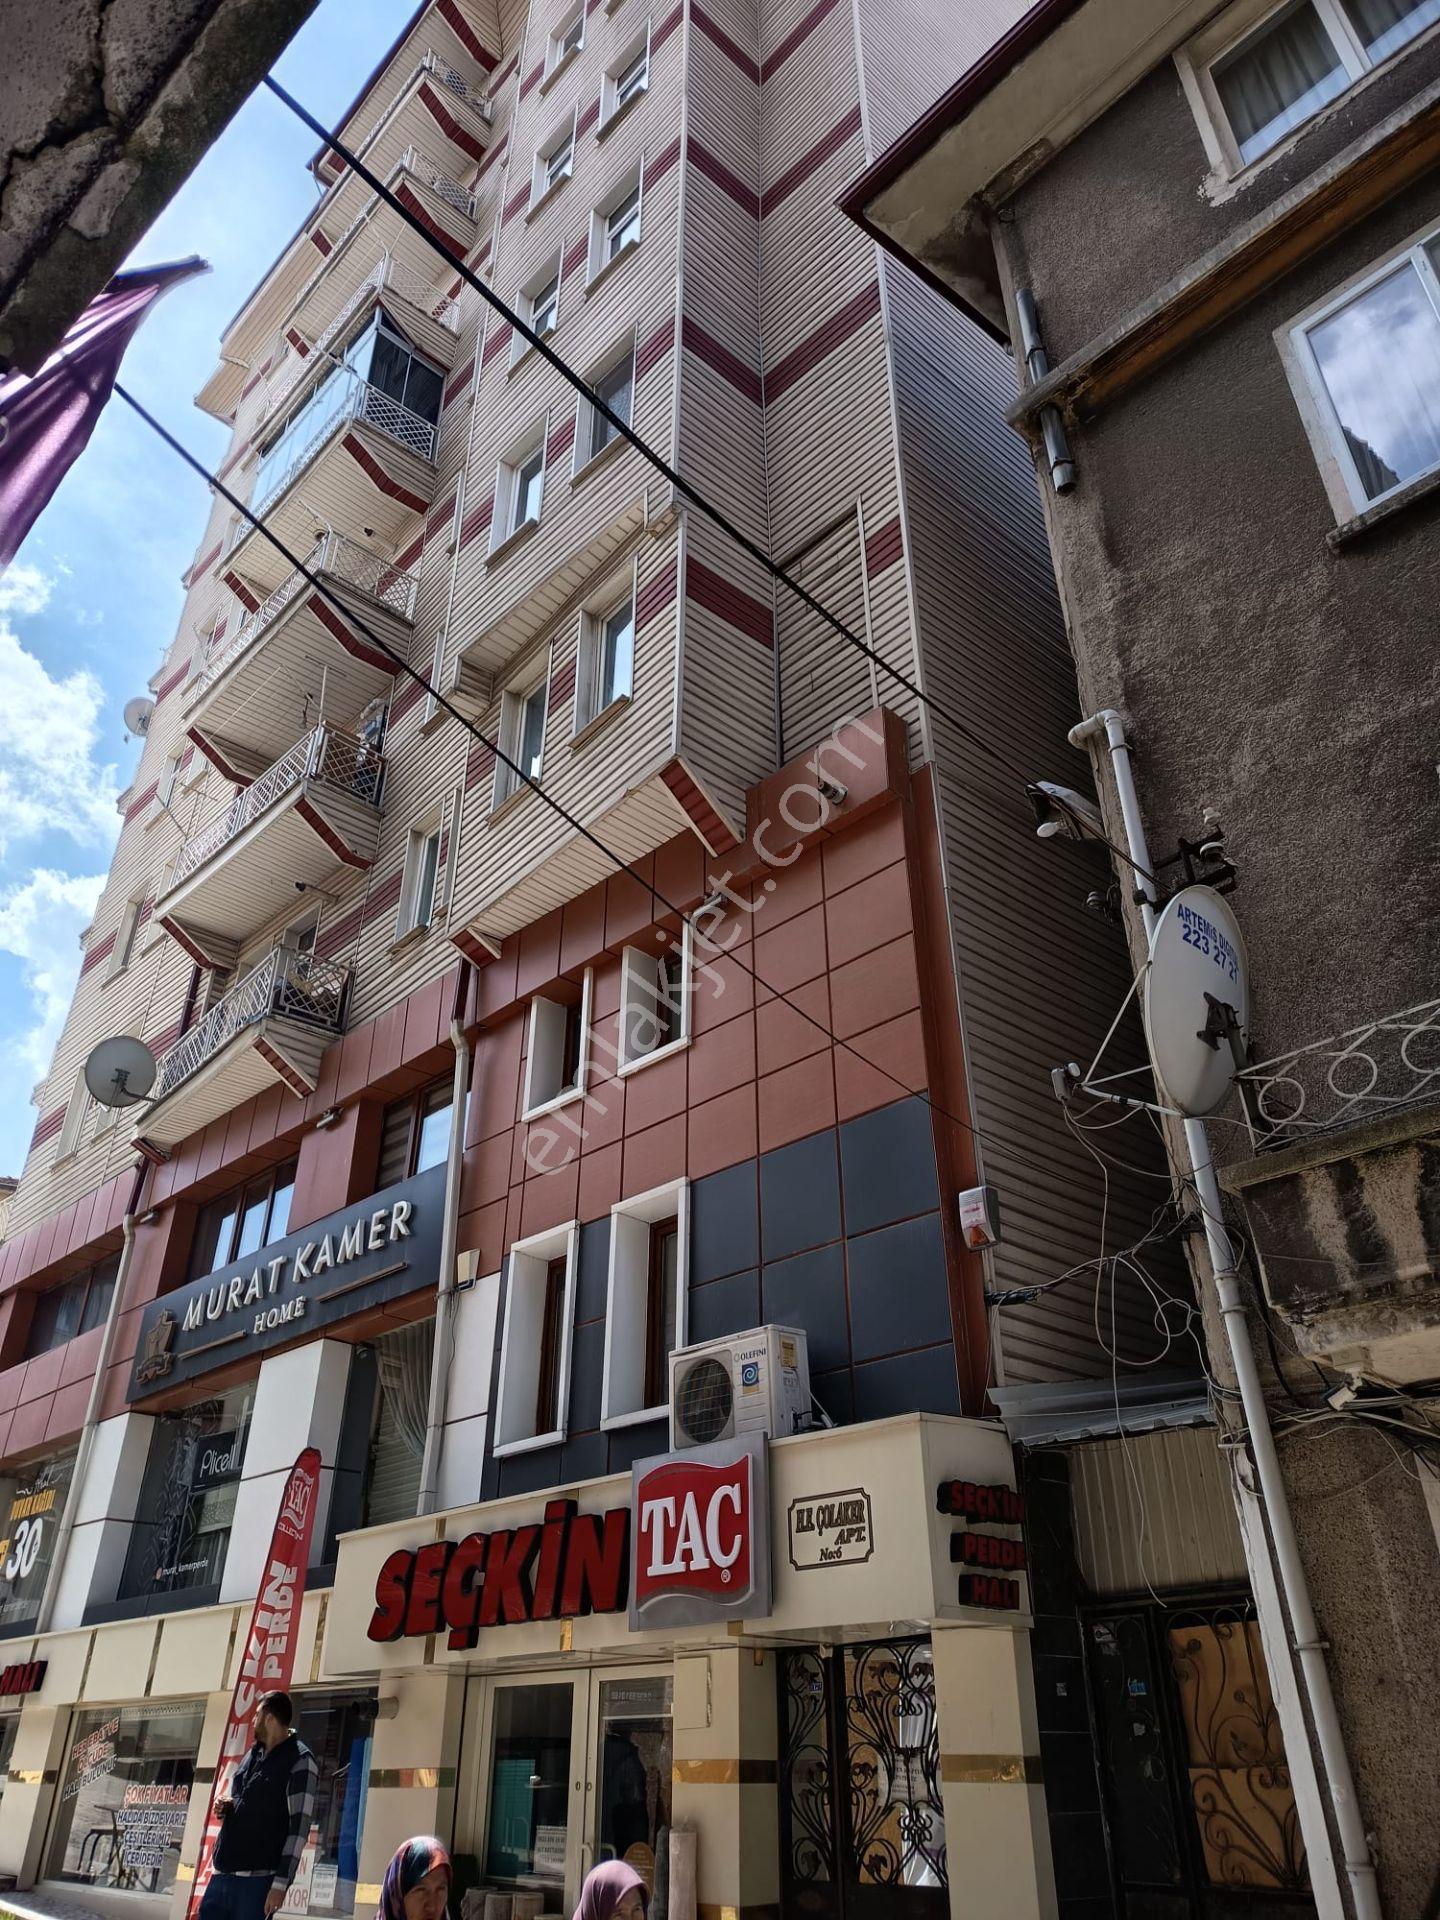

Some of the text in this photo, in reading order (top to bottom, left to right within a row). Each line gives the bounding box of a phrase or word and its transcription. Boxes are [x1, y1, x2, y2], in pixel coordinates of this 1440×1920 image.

[1182, 923, 1210, 955] 223
[1213, 944, 1227, 970] 27
[181, 1199, 413, 1333] MURAT KAMER
[252, 1295, 308, 1335] HOME
[815, 1499, 866, 1537] ÇOLAKER
[834, 1525, 867, 1546] APT.
[6, 1518, 43, 1580] 30
[819, 1546, 843, 1562] No:6
[367, 1498, 631, 1651] SEÇKİN
[959, 1574, 1020, 1610] HALI
[262, 1566, 298, 1679] PERDE
[123, 1784, 145, 1808] ŞOK
